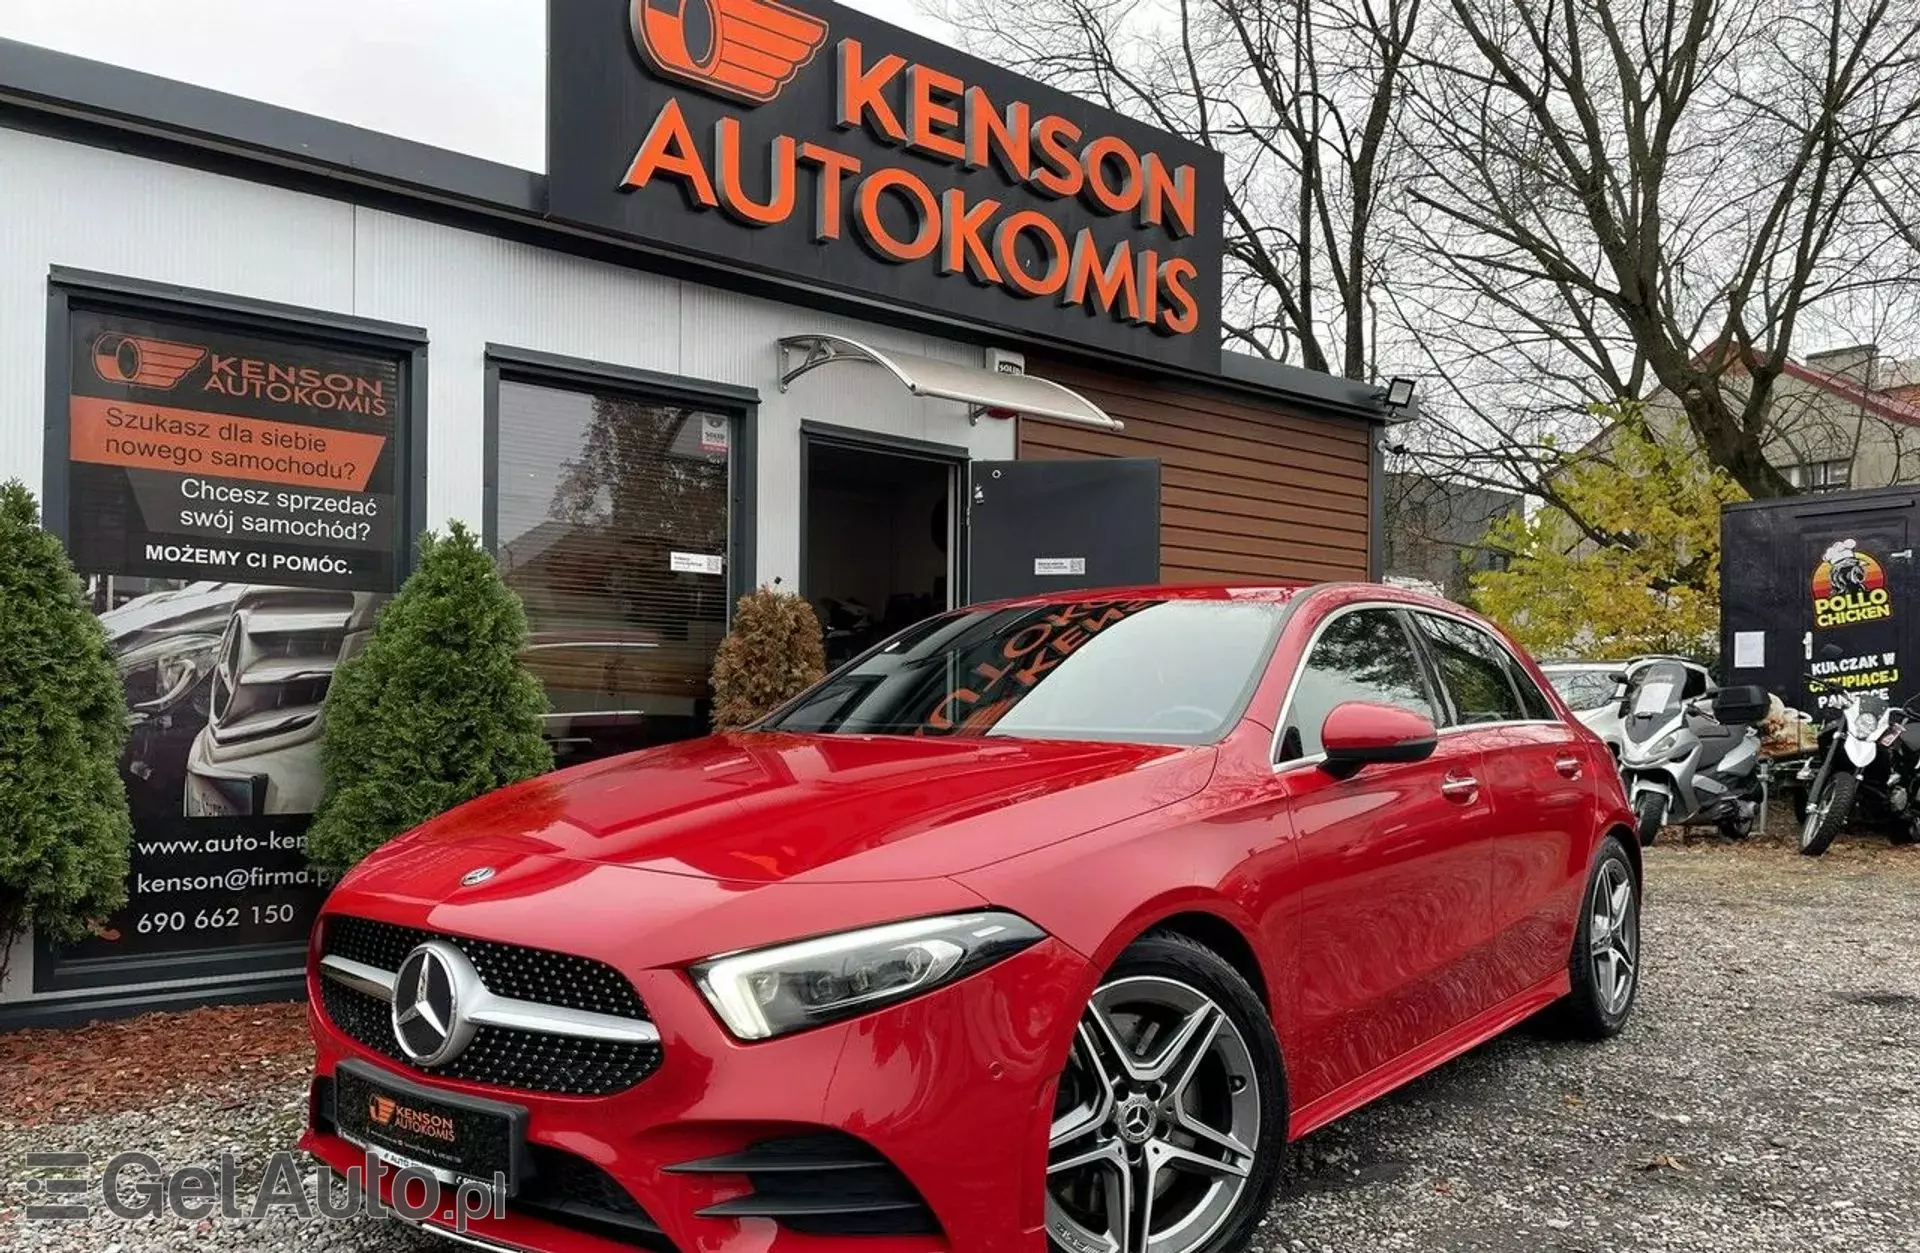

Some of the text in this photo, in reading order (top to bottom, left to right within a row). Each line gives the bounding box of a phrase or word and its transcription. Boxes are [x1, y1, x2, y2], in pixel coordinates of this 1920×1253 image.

[836, 37, 1196, 238] KENSON
[619, 97, 1198, 334] AUTOKOMIS
[211, 354, 384, 398] KENSON
[203, 374, 387, 417] AUTOKOMIS
[105, 407, 327, 453] Szukasz dla siebie
[105, 437, 356, 481] nowego samochodu?
[180, 477, 377, 518] Chcesz sprzedać
[180, 509, 371, 542] swój samochód?
[145, 543, 353, 575] MOŻEMY CI POMÓC.
[1815, 588, 1888, 615] POLLO
[1817, 604, 1890, 627] CHICKEN
[1882, 652, 1896, 666] W
[137, 867, 335, 894] kenson@firma.p
[136, 904, 294, 934] 690 662 150
[394, 1117, 456, 1143] AUTOKOMIS
[396, 1105, 453, 1129] KENSON
